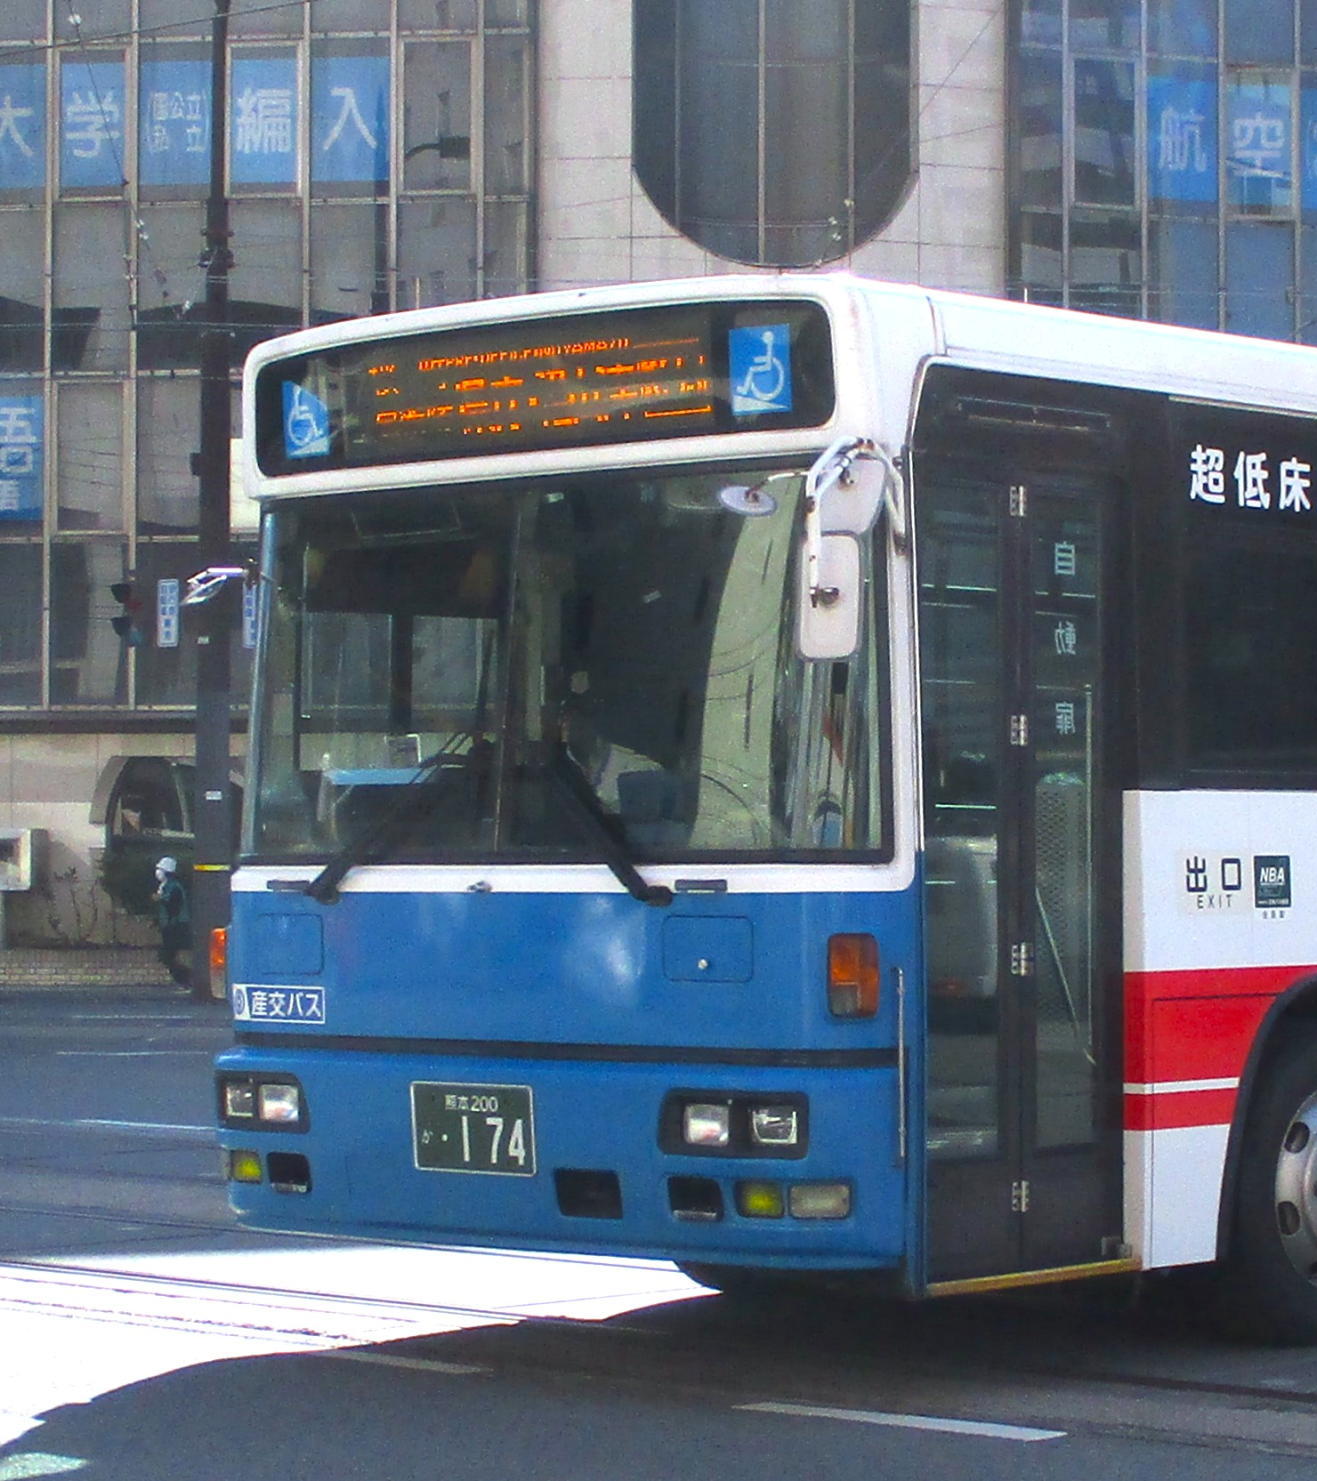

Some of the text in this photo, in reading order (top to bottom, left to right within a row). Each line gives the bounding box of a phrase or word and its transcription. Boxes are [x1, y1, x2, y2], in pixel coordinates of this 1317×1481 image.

[236, 88, 378, 154] 編入
[1160, 106, 1286, 177] 航空
[1186, 856, 1242, 892] 出口
[1260, 867, 1286, 882] NBA
[1197, 894, 1233, 909] EXIT
[251, 990, 321, 1017] 産交バス
